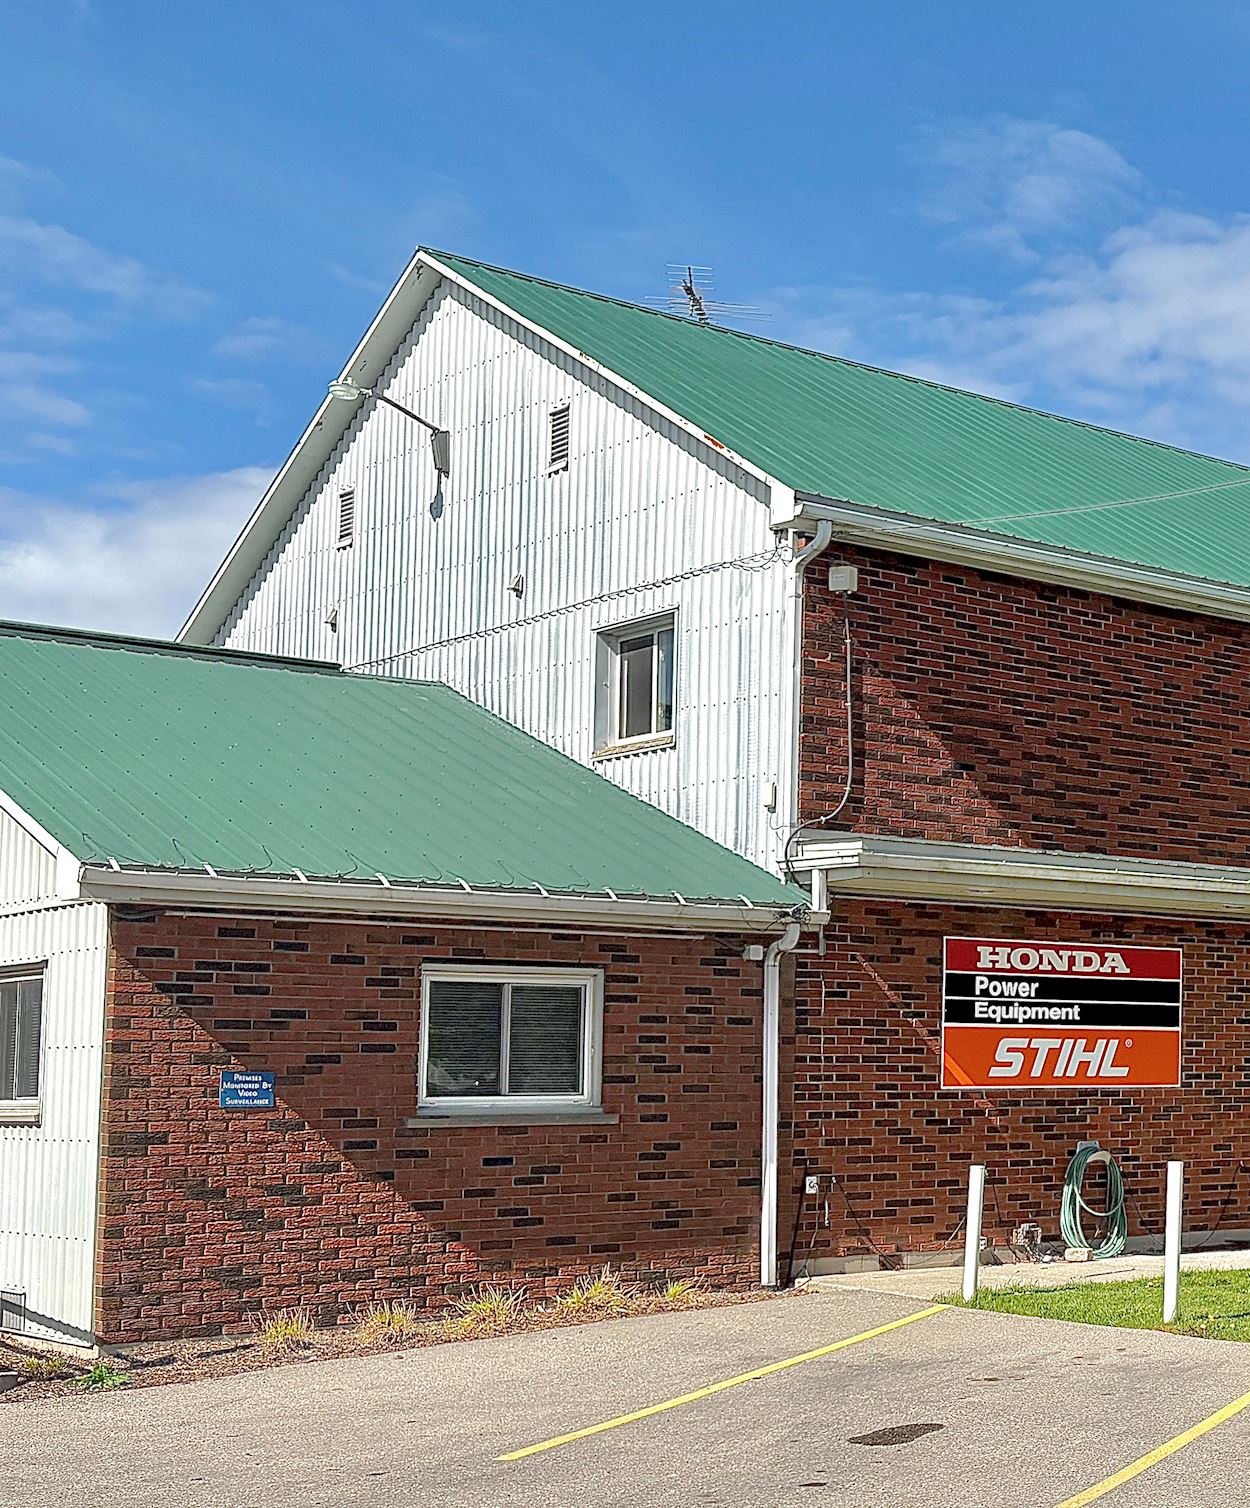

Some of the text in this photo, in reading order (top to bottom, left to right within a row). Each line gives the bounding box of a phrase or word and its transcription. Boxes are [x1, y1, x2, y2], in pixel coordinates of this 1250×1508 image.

[976, 946, 1130, 973] HONDA
[975, 976, 1039, 997] Power
[974, 1001, 1080, 1023] Equipment
